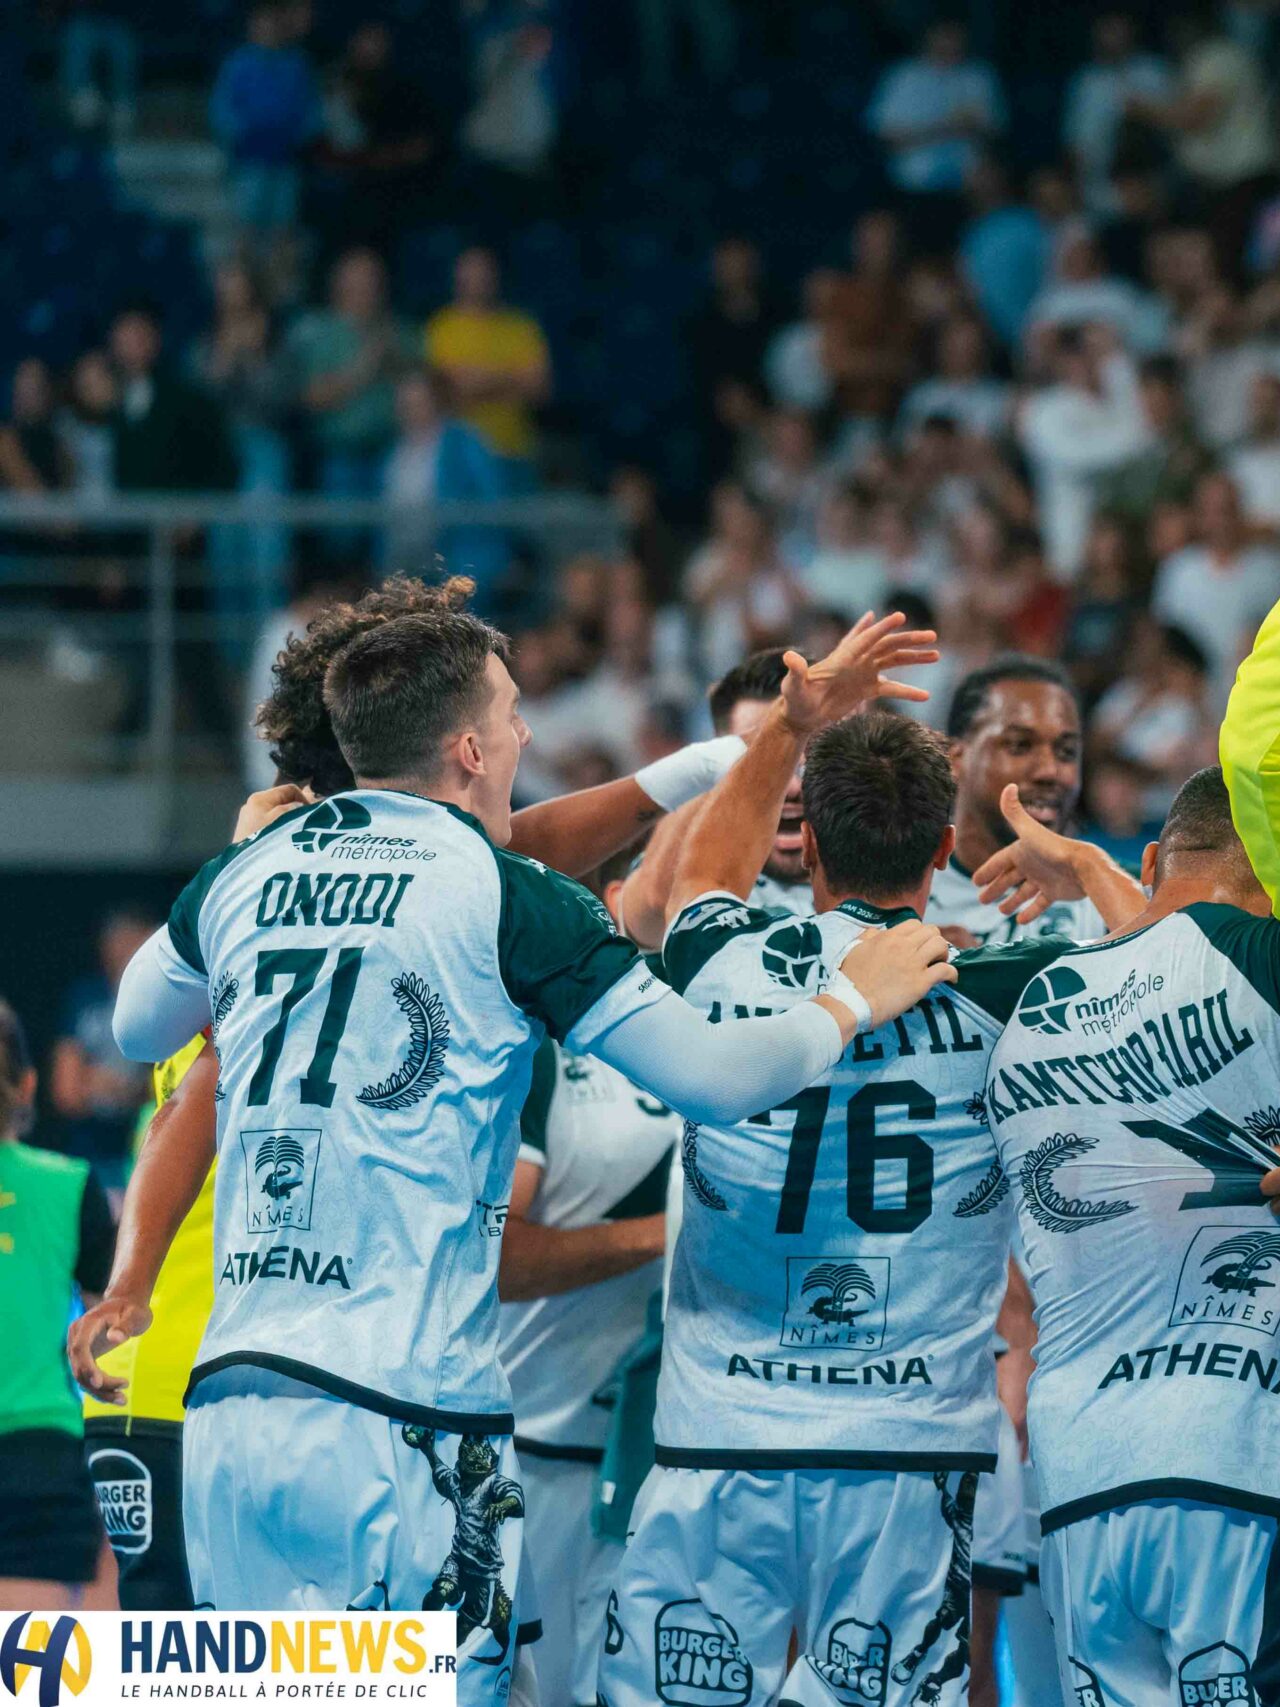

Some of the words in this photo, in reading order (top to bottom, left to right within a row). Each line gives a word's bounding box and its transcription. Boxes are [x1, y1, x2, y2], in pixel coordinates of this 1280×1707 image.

[330, 845, 437, 863] métropole
[341, 833, 418, 847] nîmes
[255, 871, 415, 927] ONODI
[1075, 969, 1136, 1019] nîmes
[247, 946, 365, 1108] 71
[747, 1079, 937, 1234] 76
[252, 1204, 304, 1227] NÎMES
[1181, 1295, 1274, 1326] NÎMES
[790, 1325, 876, 1345] NÎMES
[659, 1630, 748, 1666] BURGER
[660, 1652, 749, 1690] KING
